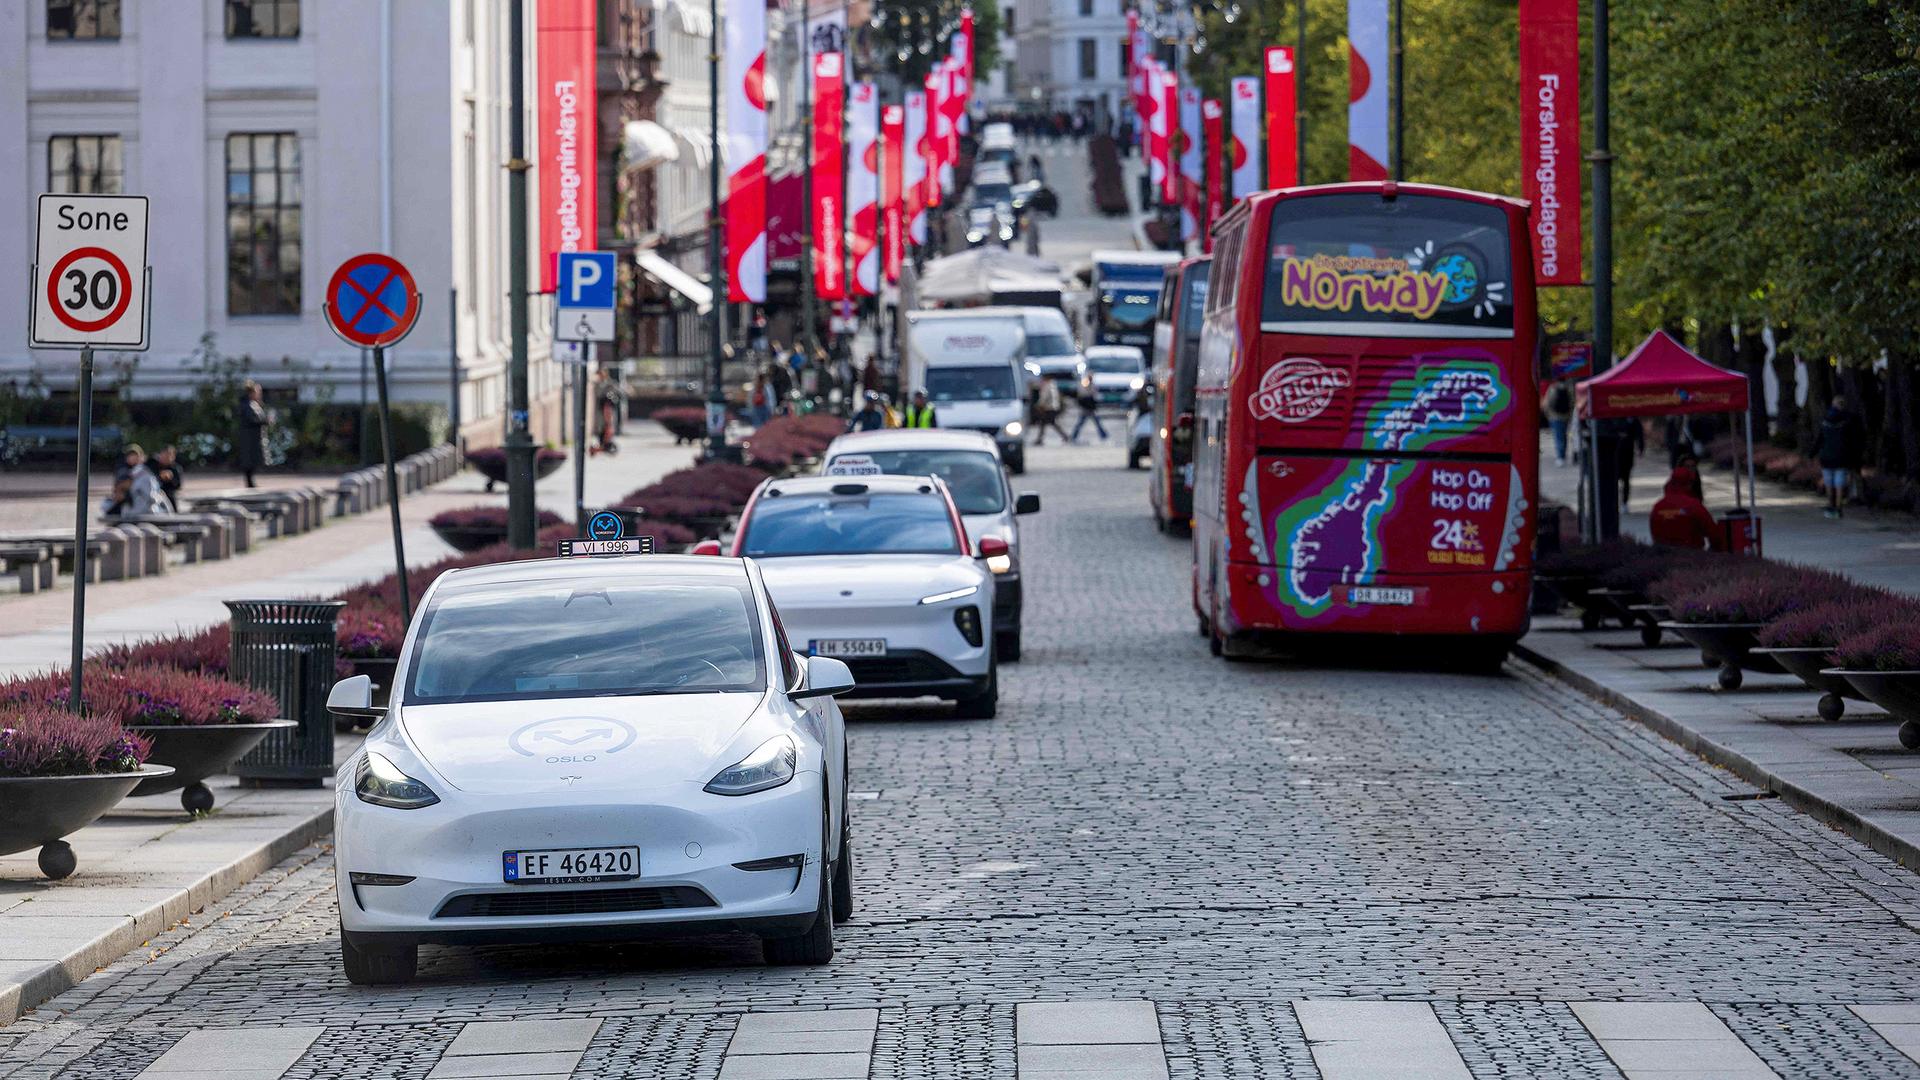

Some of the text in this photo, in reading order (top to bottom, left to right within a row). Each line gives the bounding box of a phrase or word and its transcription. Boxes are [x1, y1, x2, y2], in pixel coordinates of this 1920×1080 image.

[1536, 74, 1560, 277] Forskningsdagene
[57, 204, 129, 231] Sone
[64, 268, 117, 310] 30
[571, 258, 603, 302] P
[1284, 257, 1448, 319] Norway
[1259, 370, 1345, 411] OFFICIAL
[1431, 468, 1491, 490] Hop On
[1431, 490, 1494, 511] Hop Off
[583, 541, 629, 553] VI 1996
[1431, 518, 1463, 550] 24
[820, 641, 882, 653] EH 55049
[545, 754, 597, 764] OSLO
[525, 851, 632, 876] EF 46420
[544, 876, 601, 884] TESLA.COM
